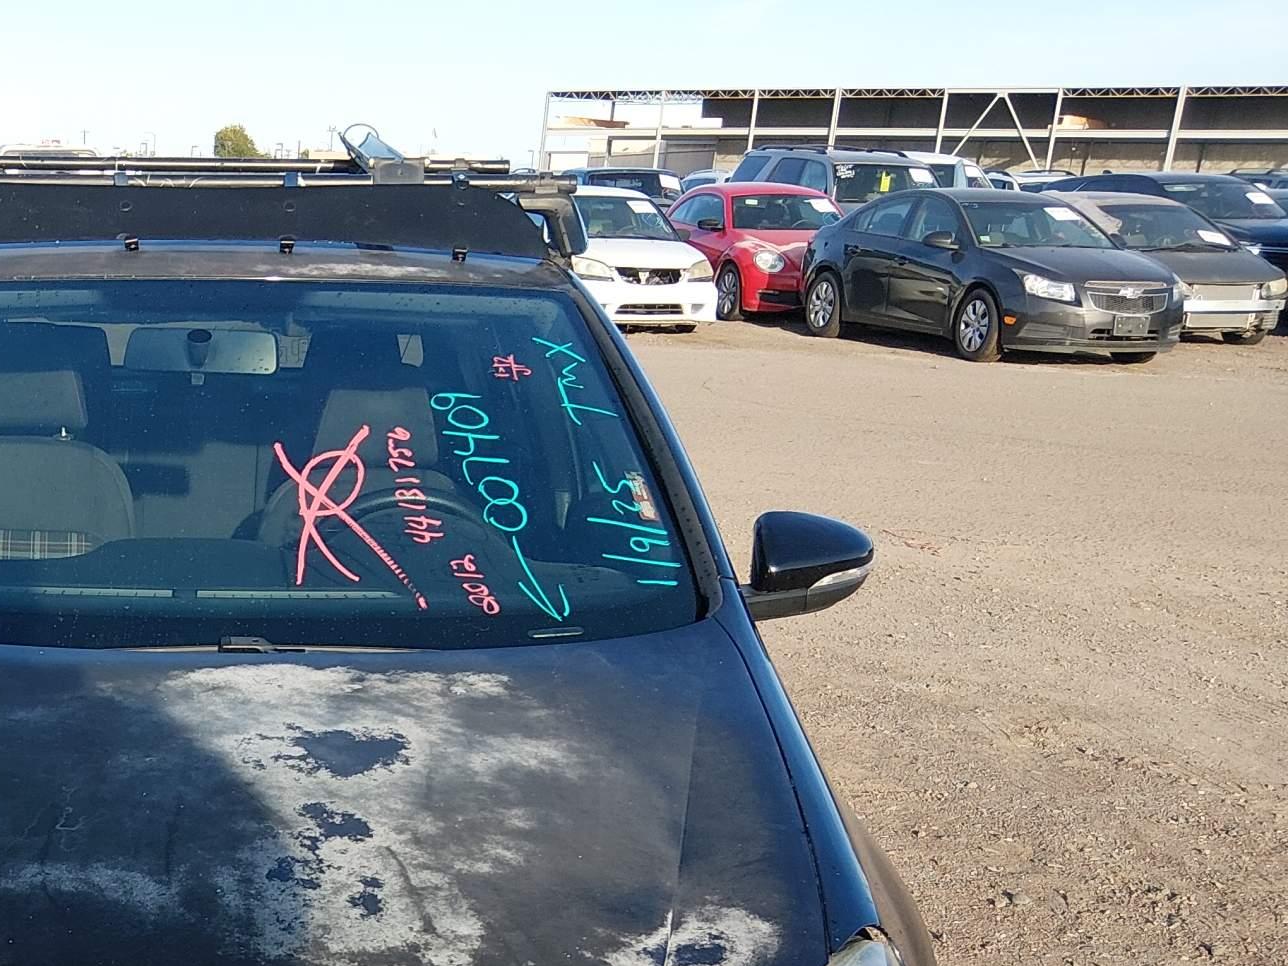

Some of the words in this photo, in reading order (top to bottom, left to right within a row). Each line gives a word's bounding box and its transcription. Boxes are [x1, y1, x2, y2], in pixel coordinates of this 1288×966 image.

[430, 392, 528, 531] 007409
[587, 461, 682, 586] 1/9/25
[449, 554, 501, 614] 2012
